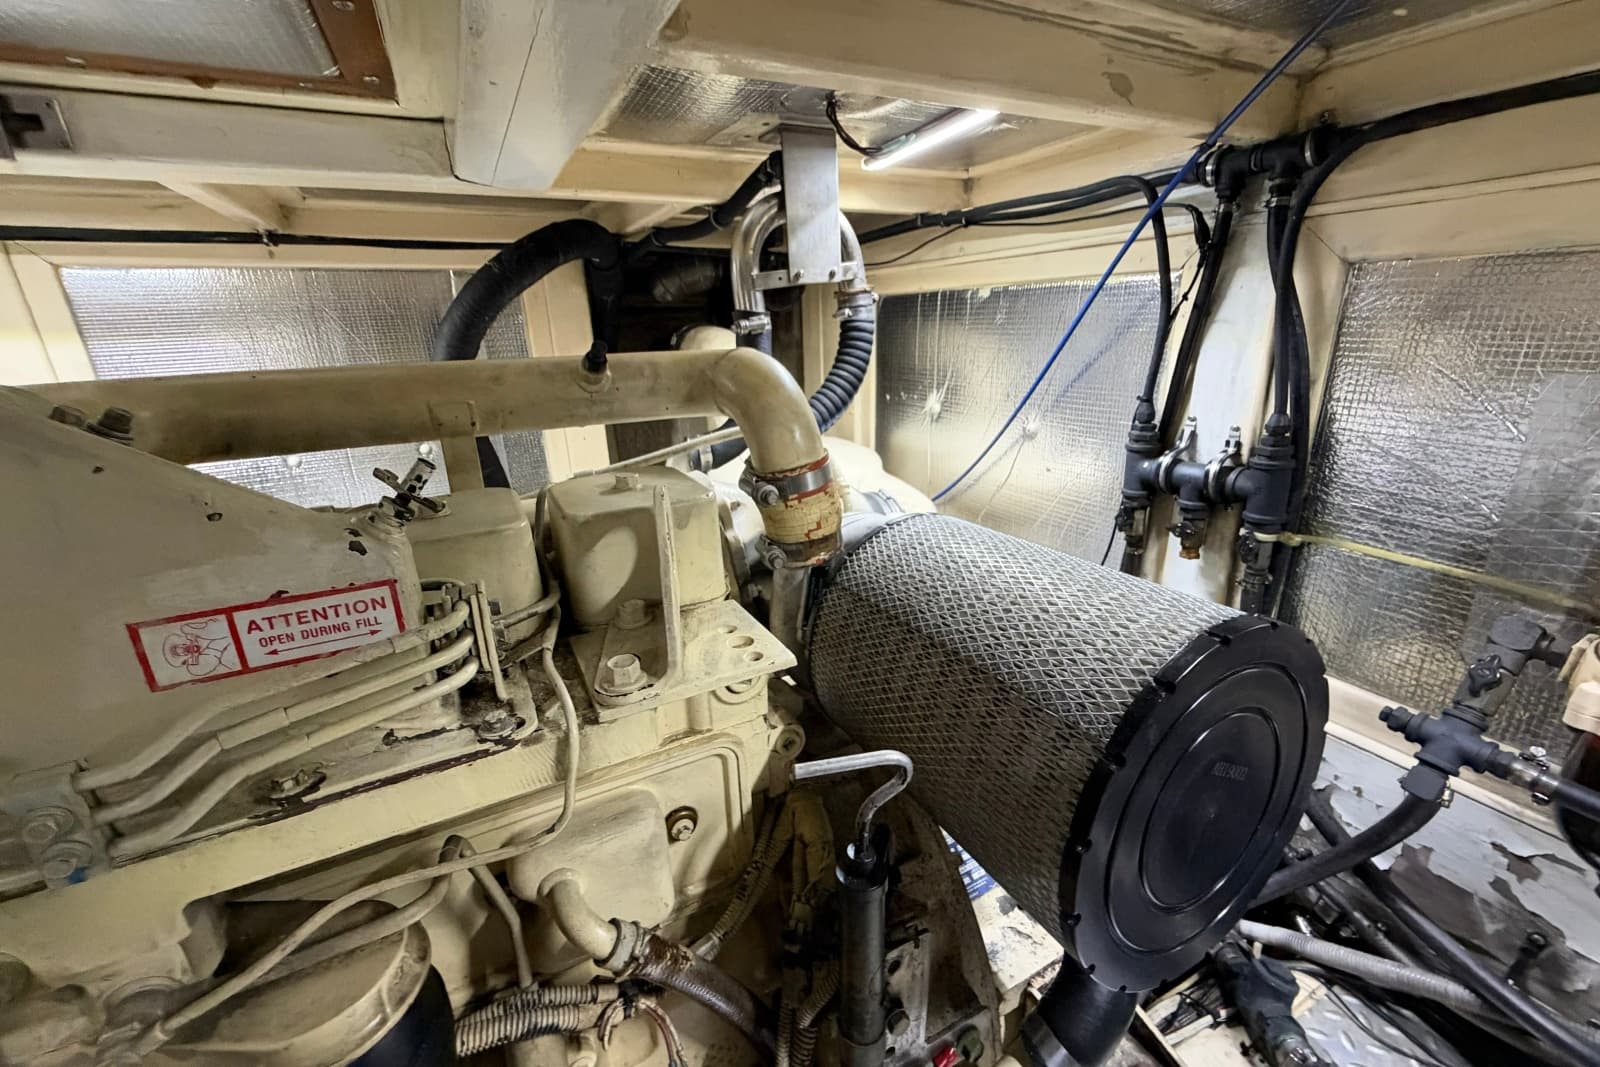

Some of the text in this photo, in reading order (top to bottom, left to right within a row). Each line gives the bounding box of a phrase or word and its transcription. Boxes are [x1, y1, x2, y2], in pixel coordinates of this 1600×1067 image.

[247, 597, 387, 634] ATTENTION
[259, 617, 382, 648] OPEN DURING FILL
